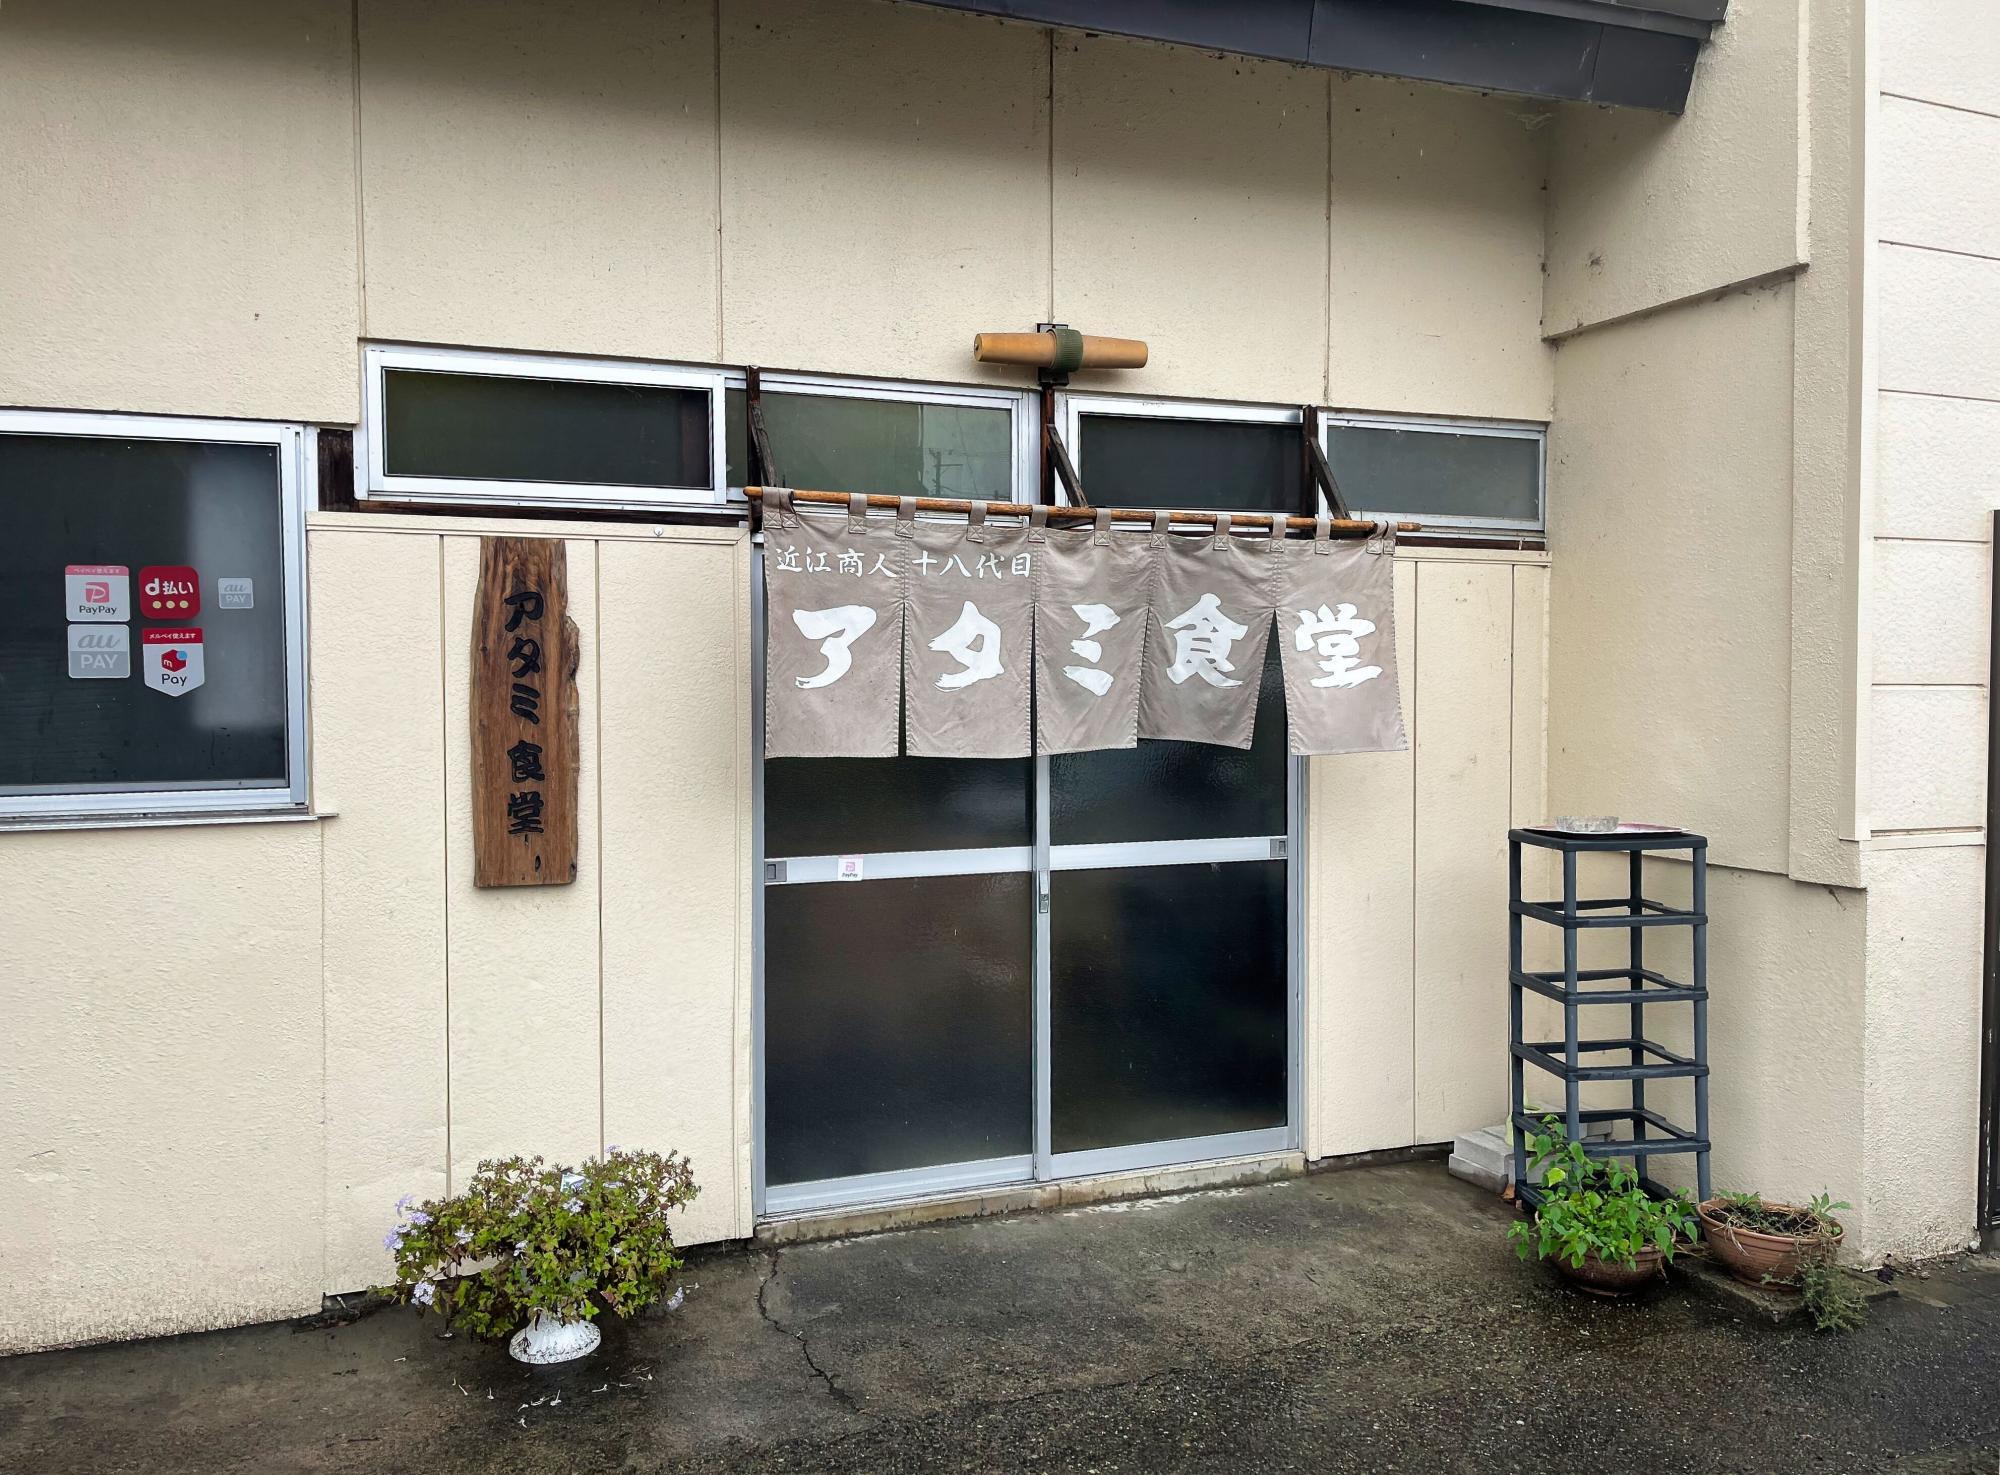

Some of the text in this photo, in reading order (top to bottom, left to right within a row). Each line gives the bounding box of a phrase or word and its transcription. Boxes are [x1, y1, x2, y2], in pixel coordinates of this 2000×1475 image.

[145, 577, 194, 596] d払い
[223, 583, 247, 593] au
[225, 594, 246, 604] PAY
[79, 604, 118, 615] PayPay
[77, 633, 121, 650] au
[792, 593, 1383, 697] アタミ食堂
[80, 654, 119, 670] PAY
[161, 673, 187, 687] Pay
[504, 591, 545, 834] アタミ食堂
